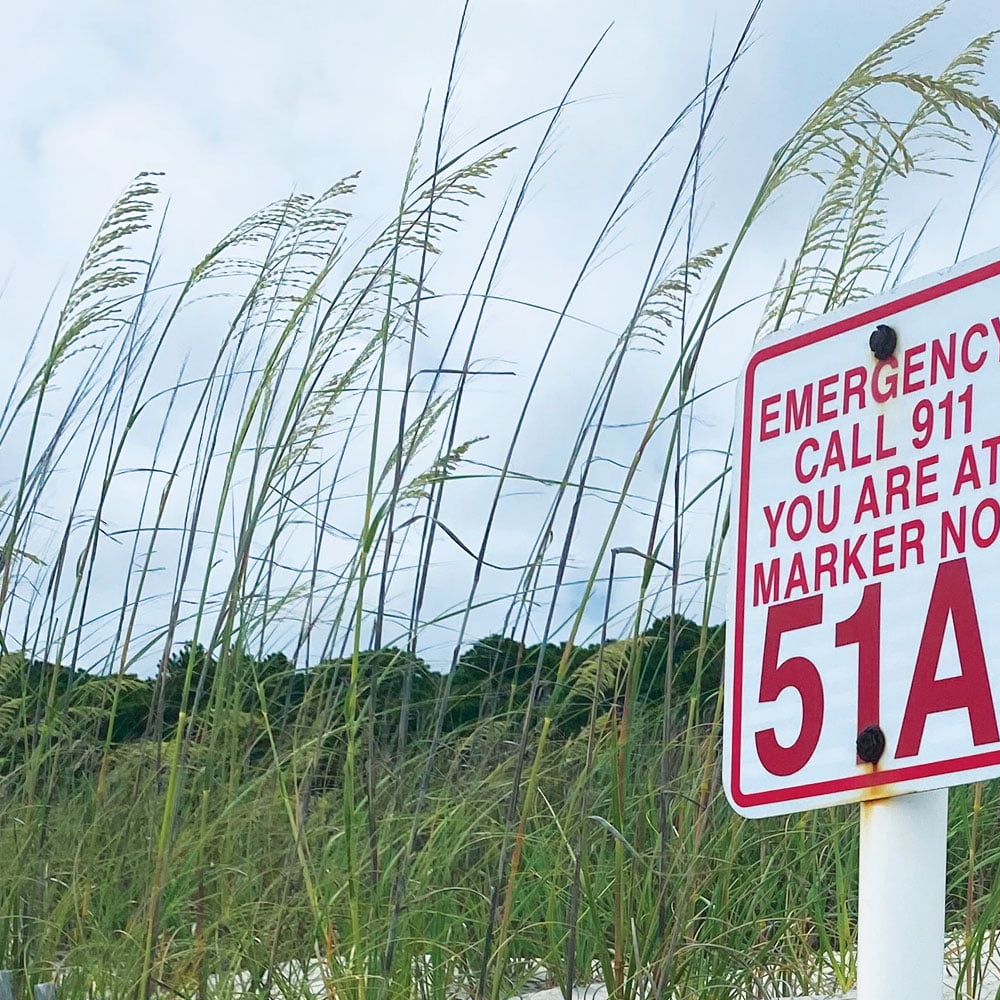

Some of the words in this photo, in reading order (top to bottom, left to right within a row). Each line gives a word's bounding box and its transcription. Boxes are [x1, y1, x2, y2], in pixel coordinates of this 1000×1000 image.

[795, 414, 897, 483] CALL
[912, 384, 973, 450] 911
[763, 485, 841, 549] YOU
[854, 456, 939, 525] ARE
[752, 519, 925, 607] MARKER
[754, 557, 1000, 777] 51A
